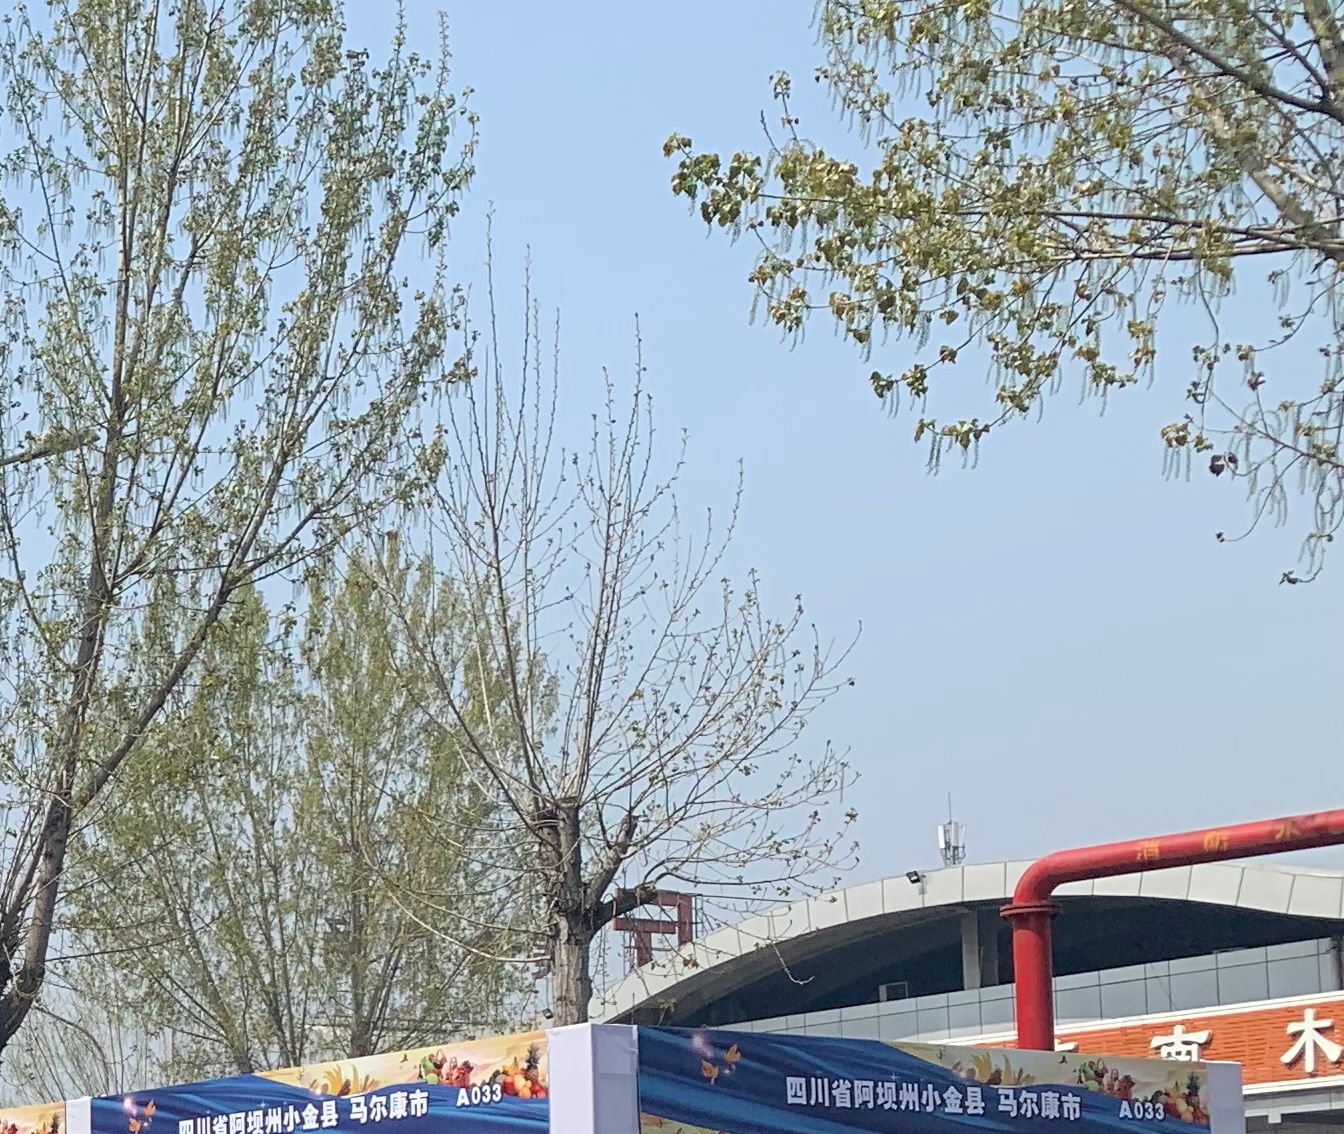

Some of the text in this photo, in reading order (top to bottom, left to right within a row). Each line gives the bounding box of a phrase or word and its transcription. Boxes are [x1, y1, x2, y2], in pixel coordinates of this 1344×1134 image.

[349, 1089, 429, 1126] 马尔康市
[456, 1083, 502, 1107] A033
[786, 1076, 1165, 1122] 四川省阿坝州小金县 马尔康市 A033
